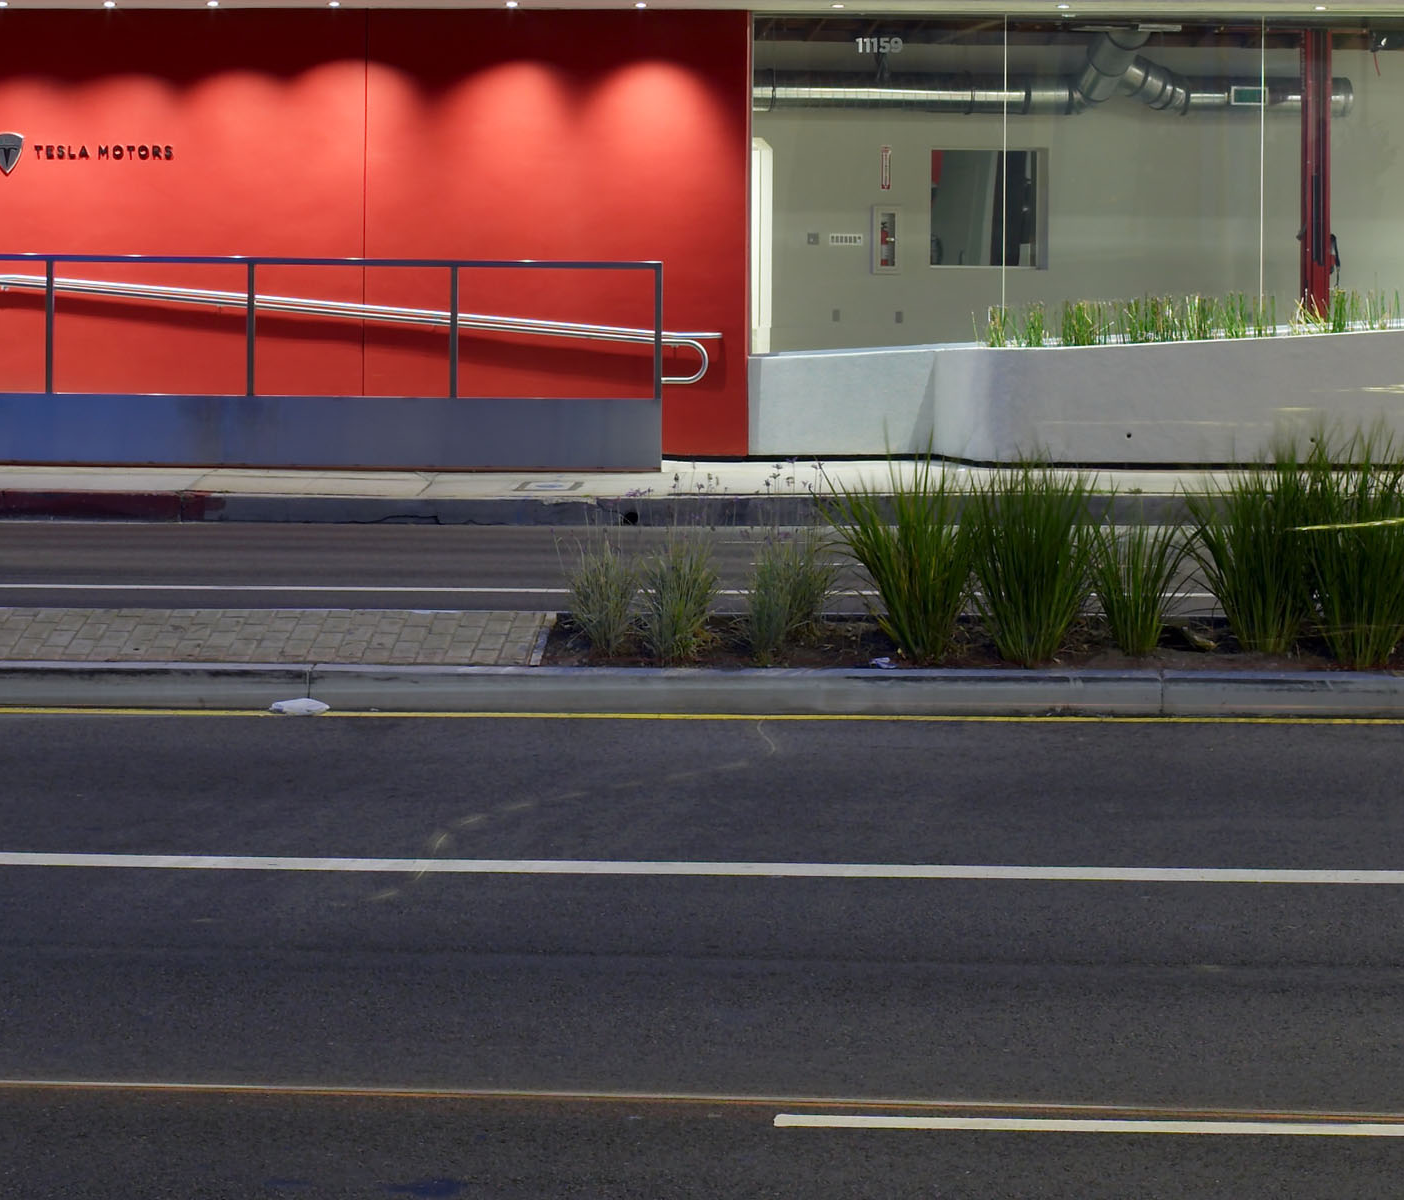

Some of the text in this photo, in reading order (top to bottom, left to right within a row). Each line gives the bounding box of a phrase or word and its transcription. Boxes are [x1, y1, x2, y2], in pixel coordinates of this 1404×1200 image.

[855, 37, 903, 53] 11159
[34, 144, 174, 161] TESLA MOTORS
